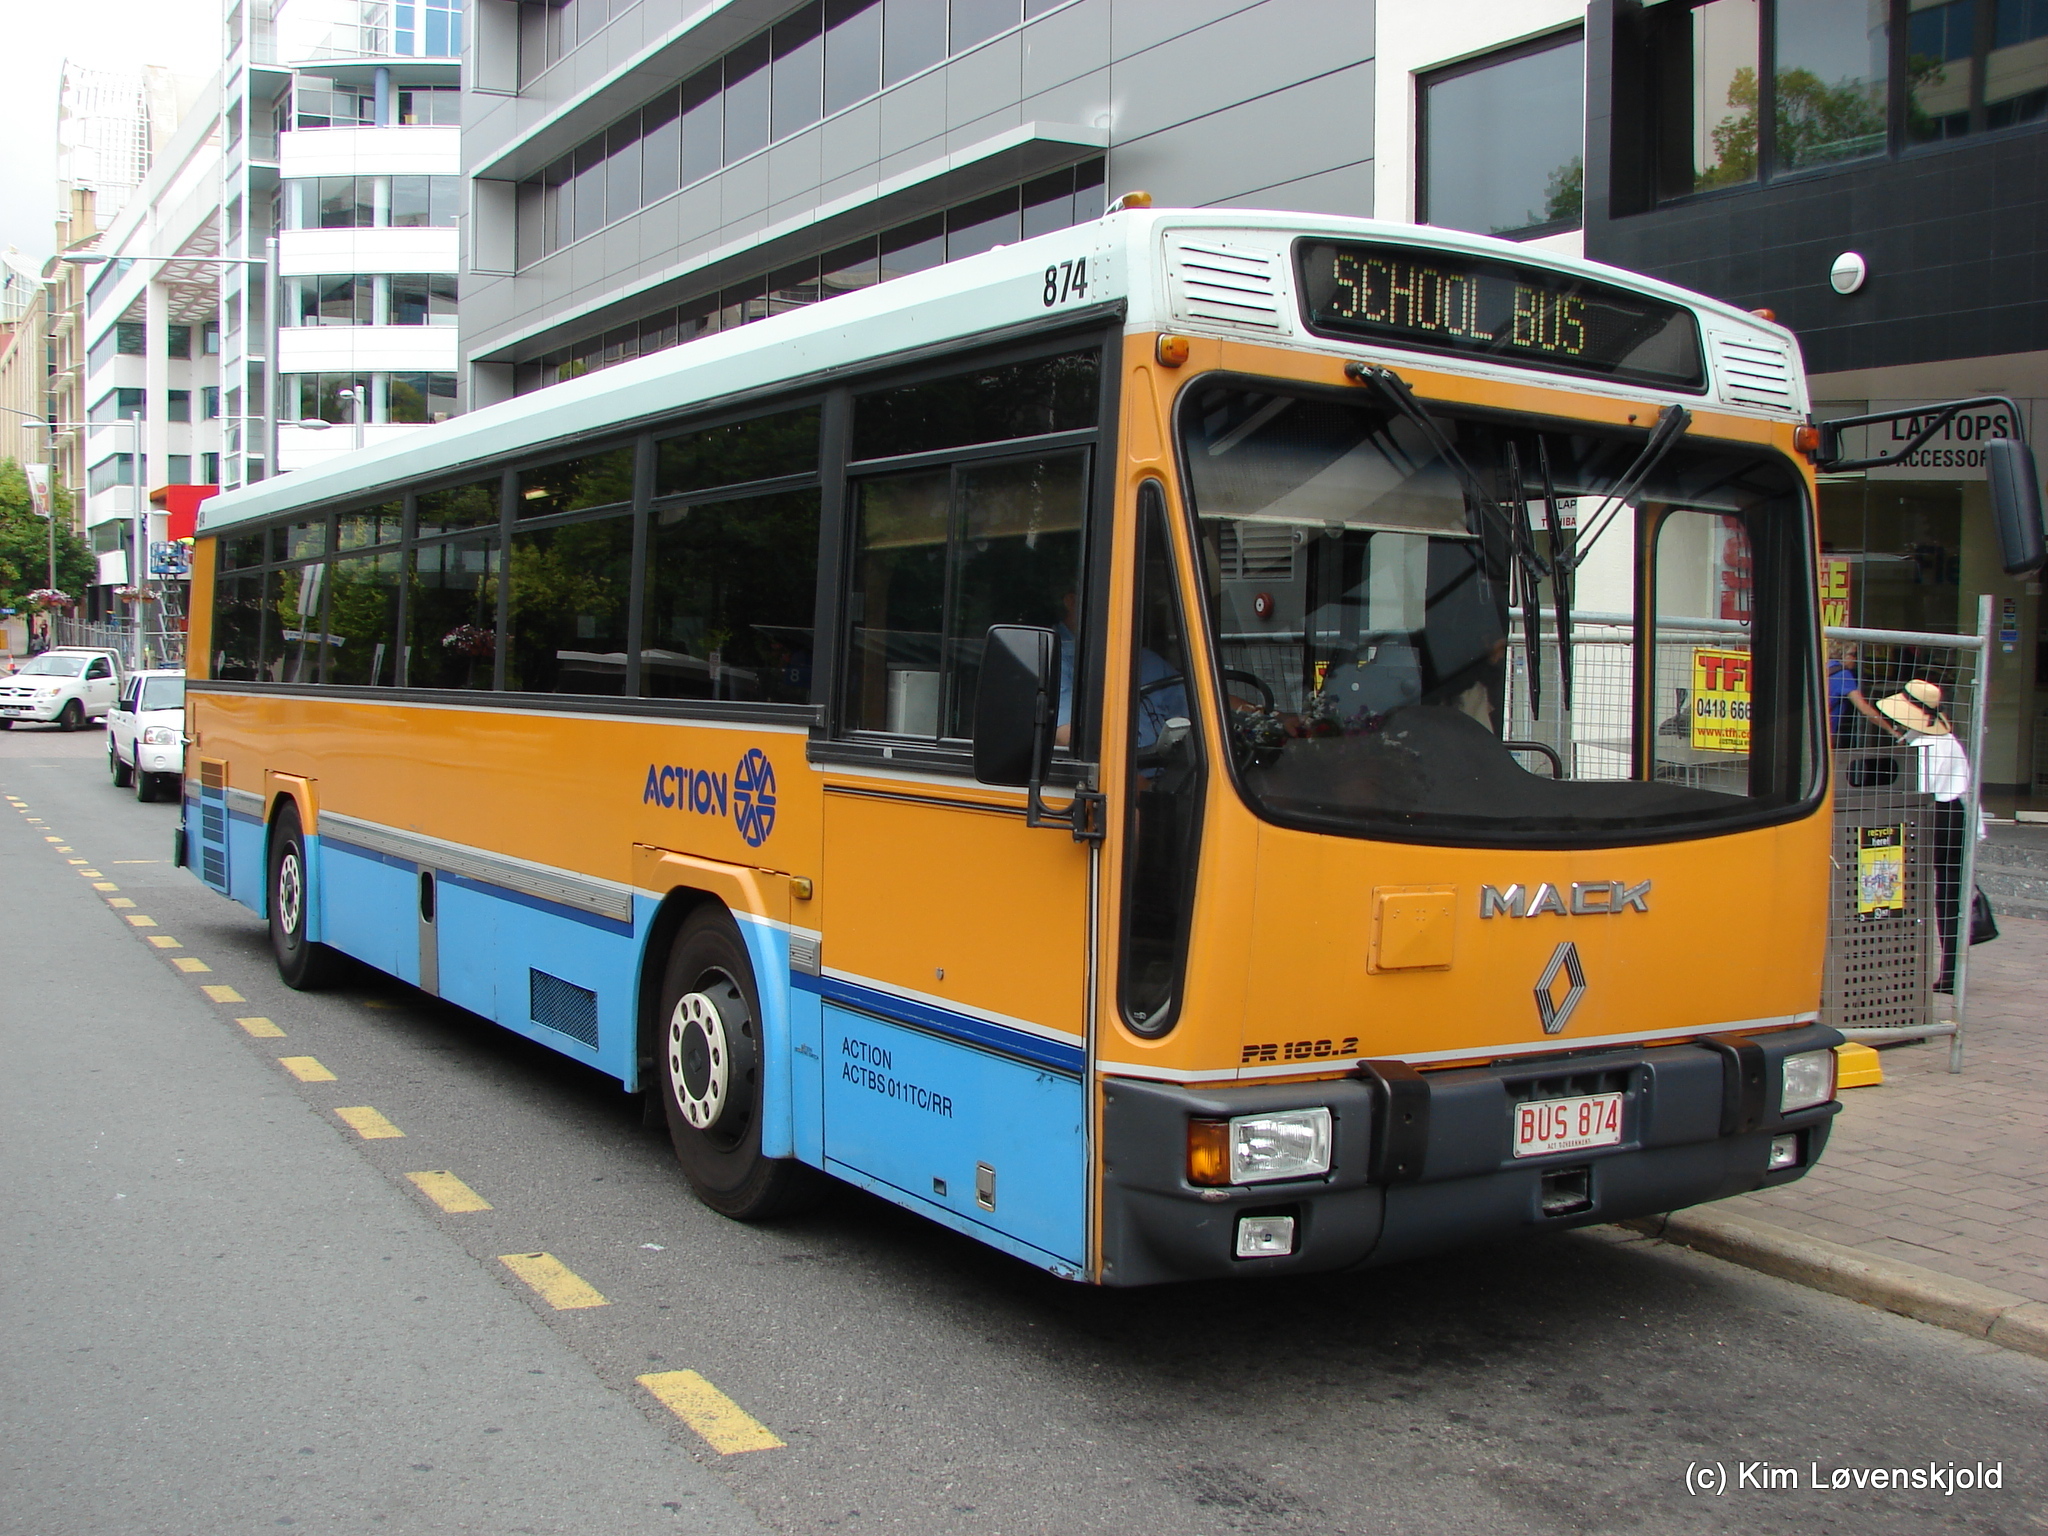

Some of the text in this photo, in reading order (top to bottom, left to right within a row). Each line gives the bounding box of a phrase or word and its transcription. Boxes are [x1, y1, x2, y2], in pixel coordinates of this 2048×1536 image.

[1043, 256, 1088, 307] 874
[1333, 254, 1585, 354] SCHOOL BUS
[1541, 517, 1577, 527] TIBA
[1698, 656, 1751, 691] TF
[1697, 698, 1726, 718] 0418
[644, 764, 727, 817] ACTION
[1480, 879, 1651, 919] MACK
[842, 1036, 892, 1070] ACTION
[1242, 1037, 1359, 1063] PR 100.2
[1521, 1100, 1617, 1144] BUS 874
